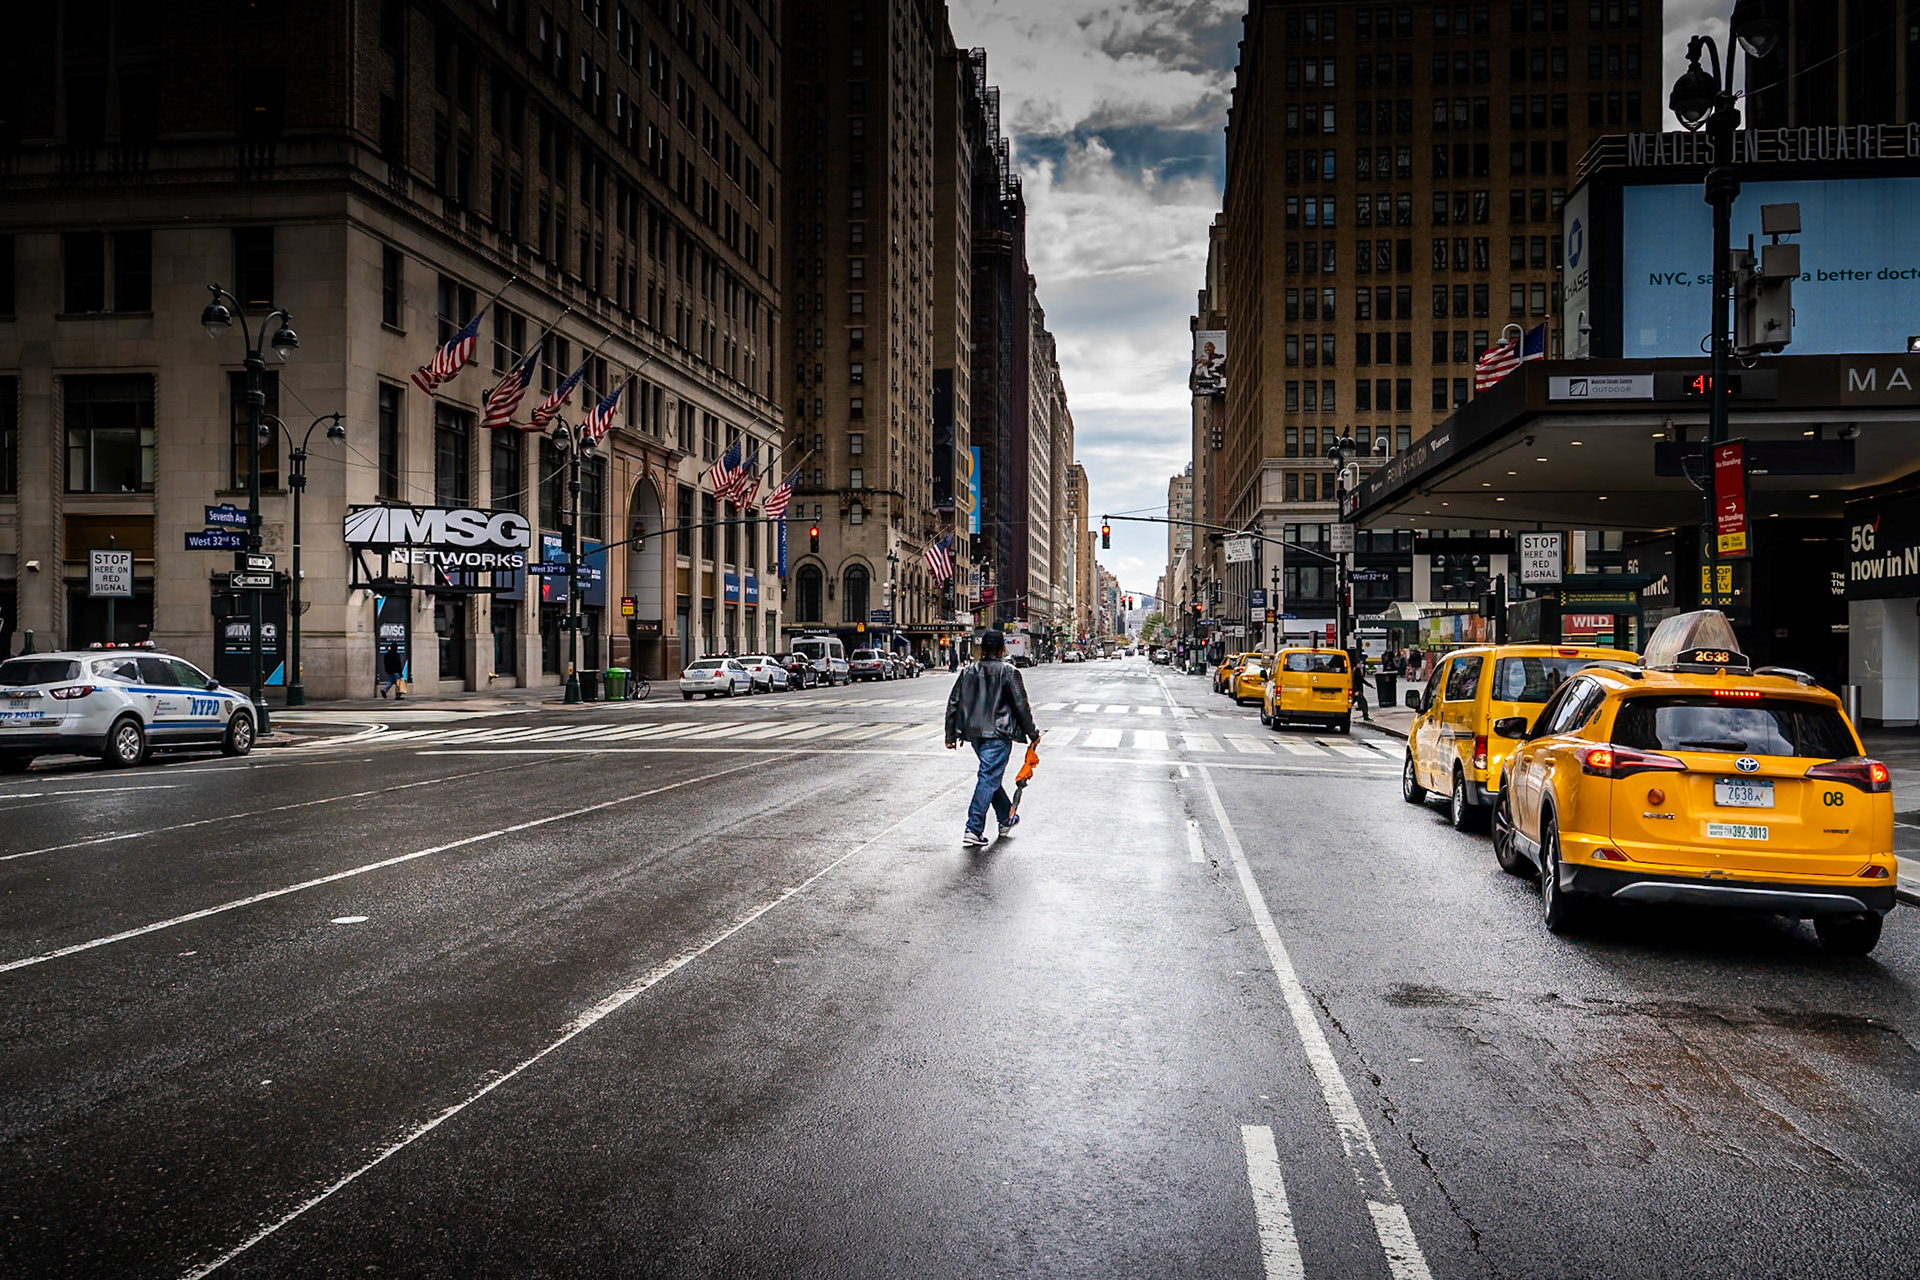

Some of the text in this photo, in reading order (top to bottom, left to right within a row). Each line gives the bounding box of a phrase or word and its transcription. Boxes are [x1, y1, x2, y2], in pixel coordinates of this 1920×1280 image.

[1628, 129, 1758, 166] MADISN
[1777, 124, 1887, 162] SQUARE
[1650, 272, 1692, 287] NYC,
[1802, 272, 1811, 282] a
[1817, 269, 1872, 282] better
[1564, 269, 1589, 302] CHASE
[1402, 446, 1427, 475] STATION
[1722, 456, 1741, 467] Standing
[209, 510, 247, 524] Seventh Ave
[1724, 512, 1743, 522] Standing
[389, 508, 530, 548] MSG
[189, 536, 240, 546] West 32nd St
[1524, 537, 1558, 549] STOP
[1850, 523, 1875, 553] 5G
[94, 554, 128, 565] STOP
[391, 550, 523, 568] NETWORKS
[1524, 550, 1558, 558] HERE ON
[1532, 560, 1550, 568] RED
[1851, 558, 1885, 581] now
[1886, 550, 1902, 578] in
[1524, 570, 1558, 578] SIGNAL
[1572, 616, 1609, 628] WILD
[239, 624, 276, 636] MG
[386, 625, 405, 636] MSG
[1695, 651, 1730, 662] 2G38
[189, 699, 219, 716] NYPD
[15, 711, 45, 719] POLICE
[1823, 791, 1844, 806] 08
[1732, 825, 1767, 839] 392-3013
